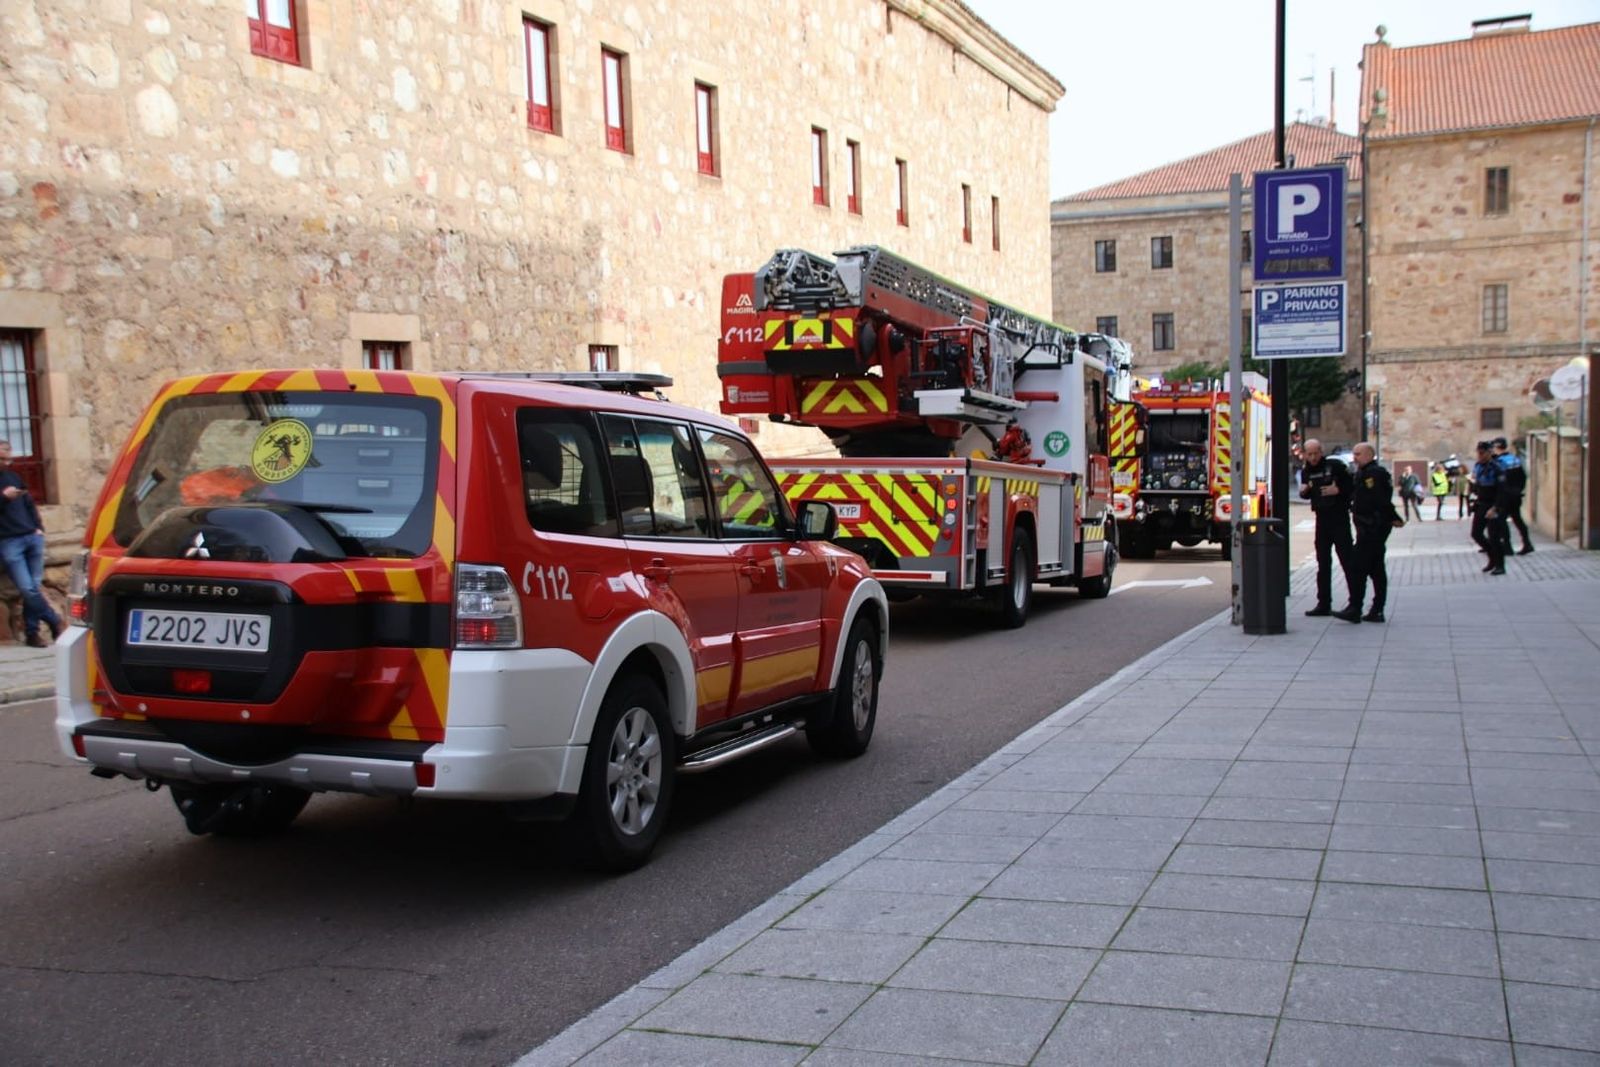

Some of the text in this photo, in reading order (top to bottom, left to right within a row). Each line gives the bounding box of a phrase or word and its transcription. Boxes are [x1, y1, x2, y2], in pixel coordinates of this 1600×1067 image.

[1278, 184, 1320, 233] P
[1261, 290, 1279, 311] P
[1284, 286, 1339, 299] PARKING
[1284, 299, 1339, 312] PRIVADO
[736, 327, 764, 343] 112
[838, 506, 857, 517] KYP
[143, 582, 239, 597] MONTERO
[535, 565, 573, 601] 112
[146, 615, 207, 644] 2202
[216, 618, 262, 647] JVS
